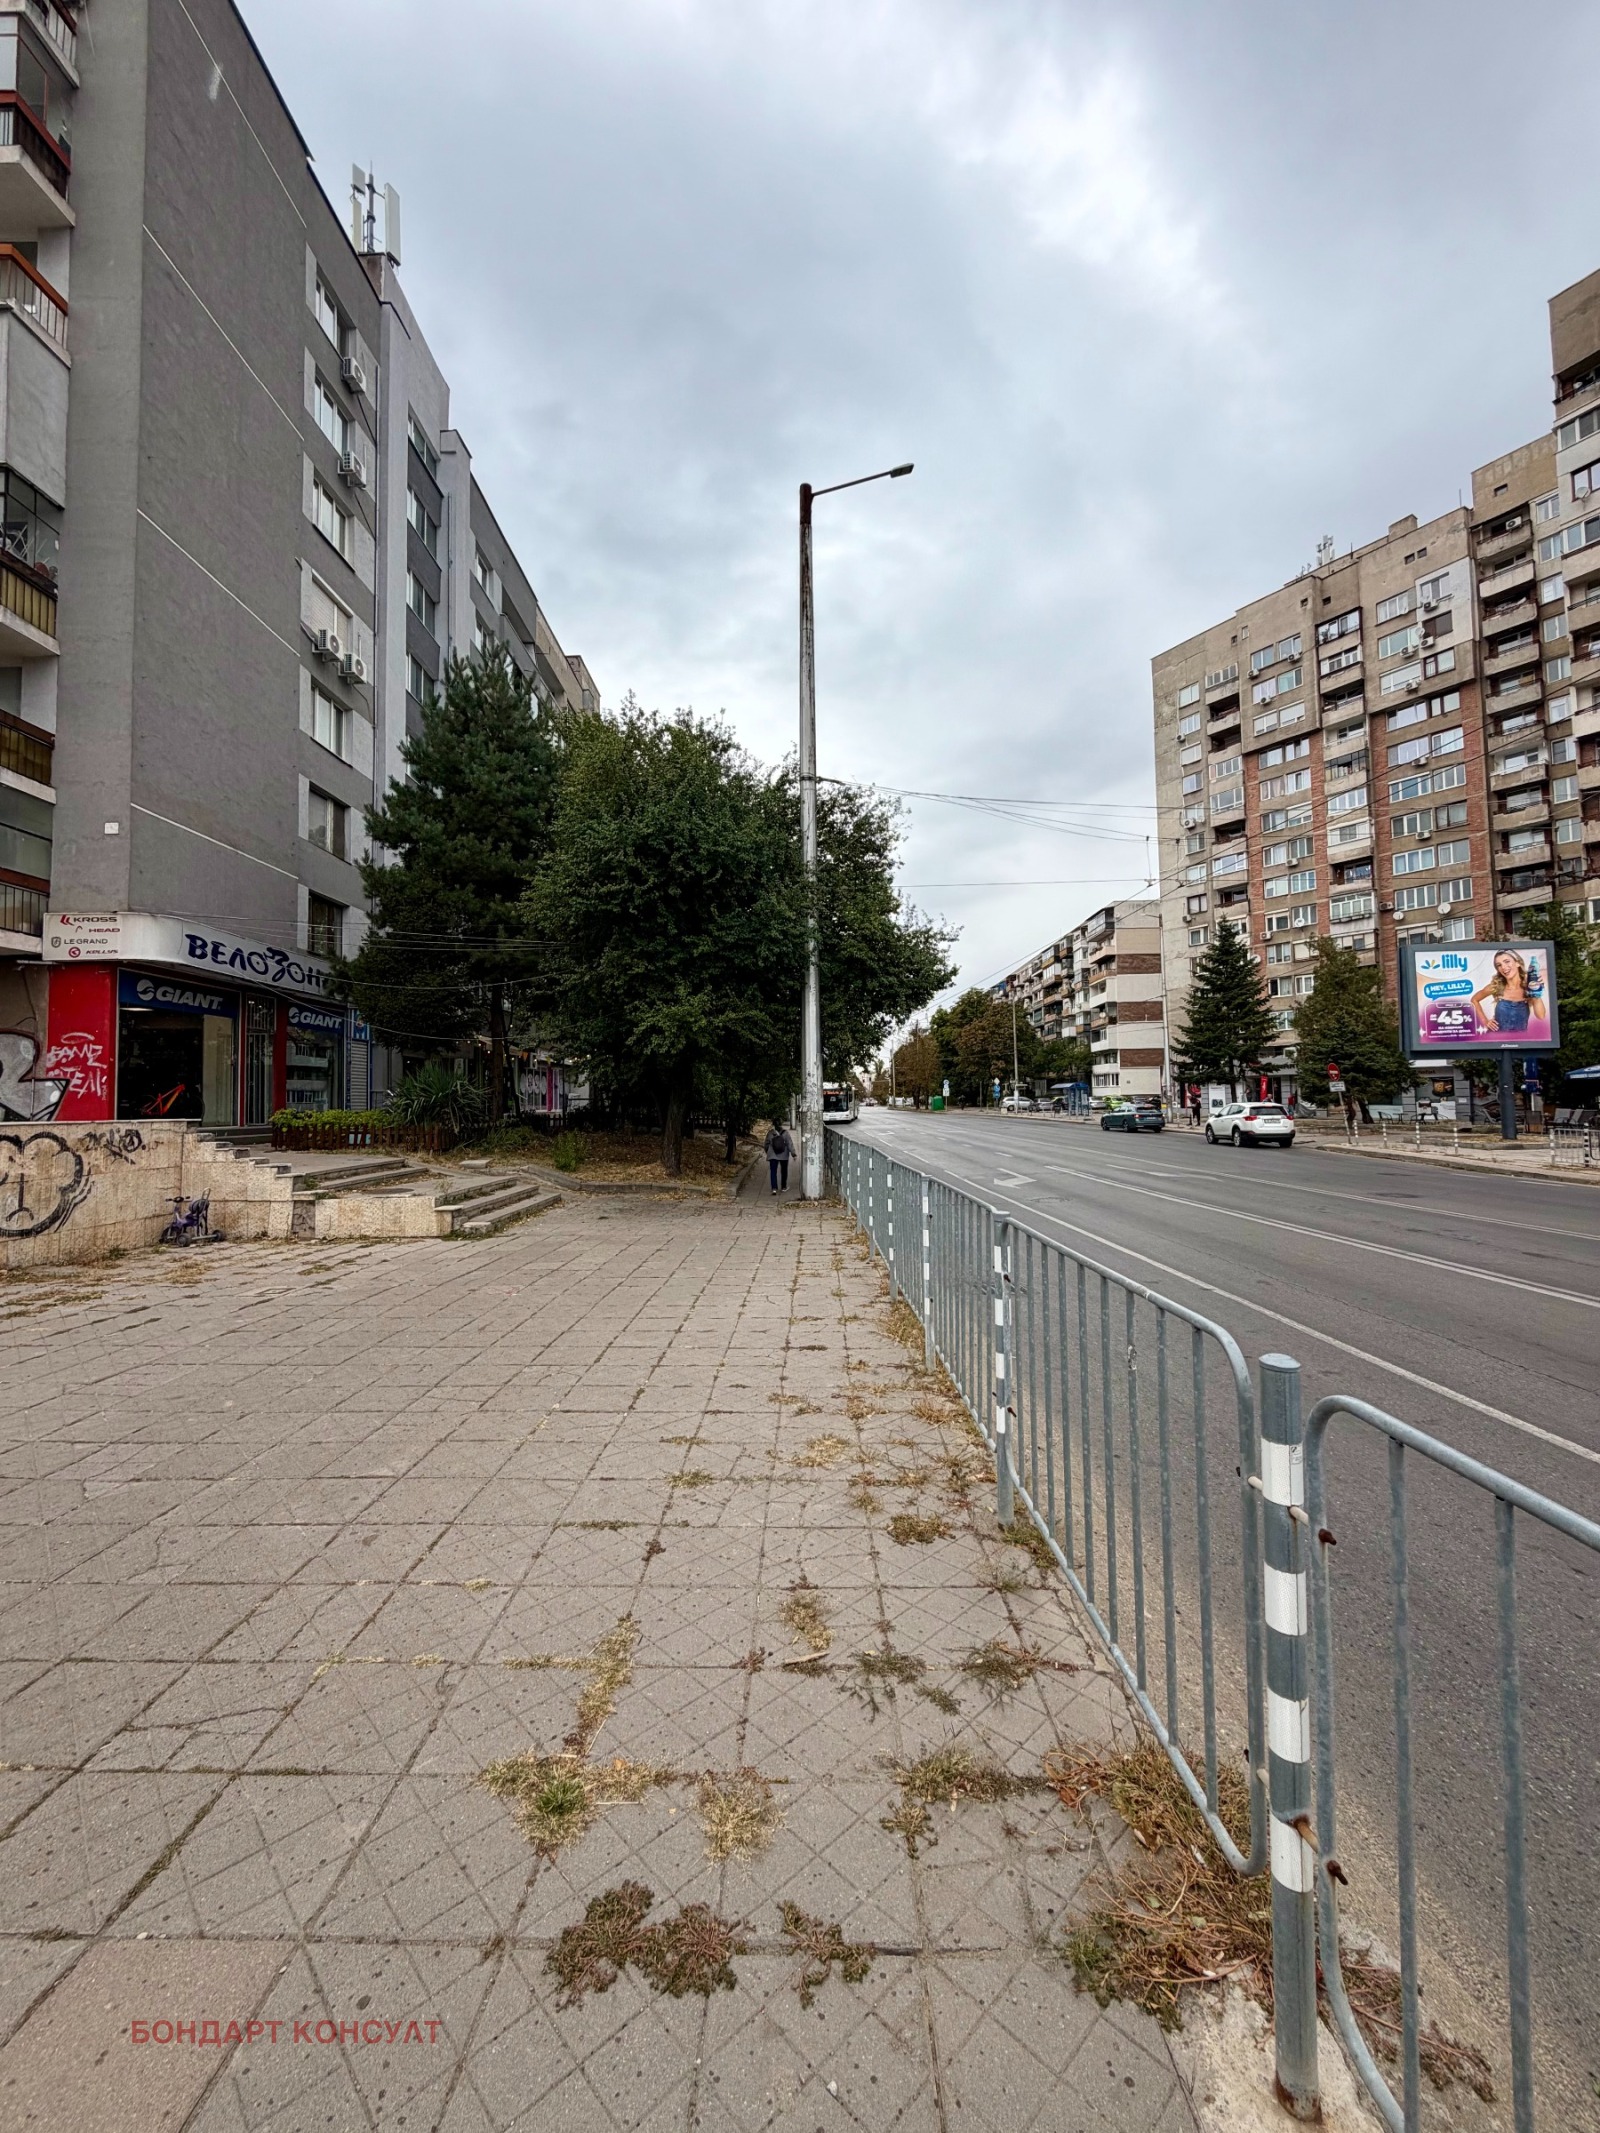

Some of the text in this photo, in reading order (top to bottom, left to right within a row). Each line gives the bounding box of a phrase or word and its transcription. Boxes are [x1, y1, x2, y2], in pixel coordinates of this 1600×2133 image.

[1441, 953, 1467, 972] lilly
[156, 985, 223, 1010] GIANT
[300, 1011, 342, 1029] GIANT
